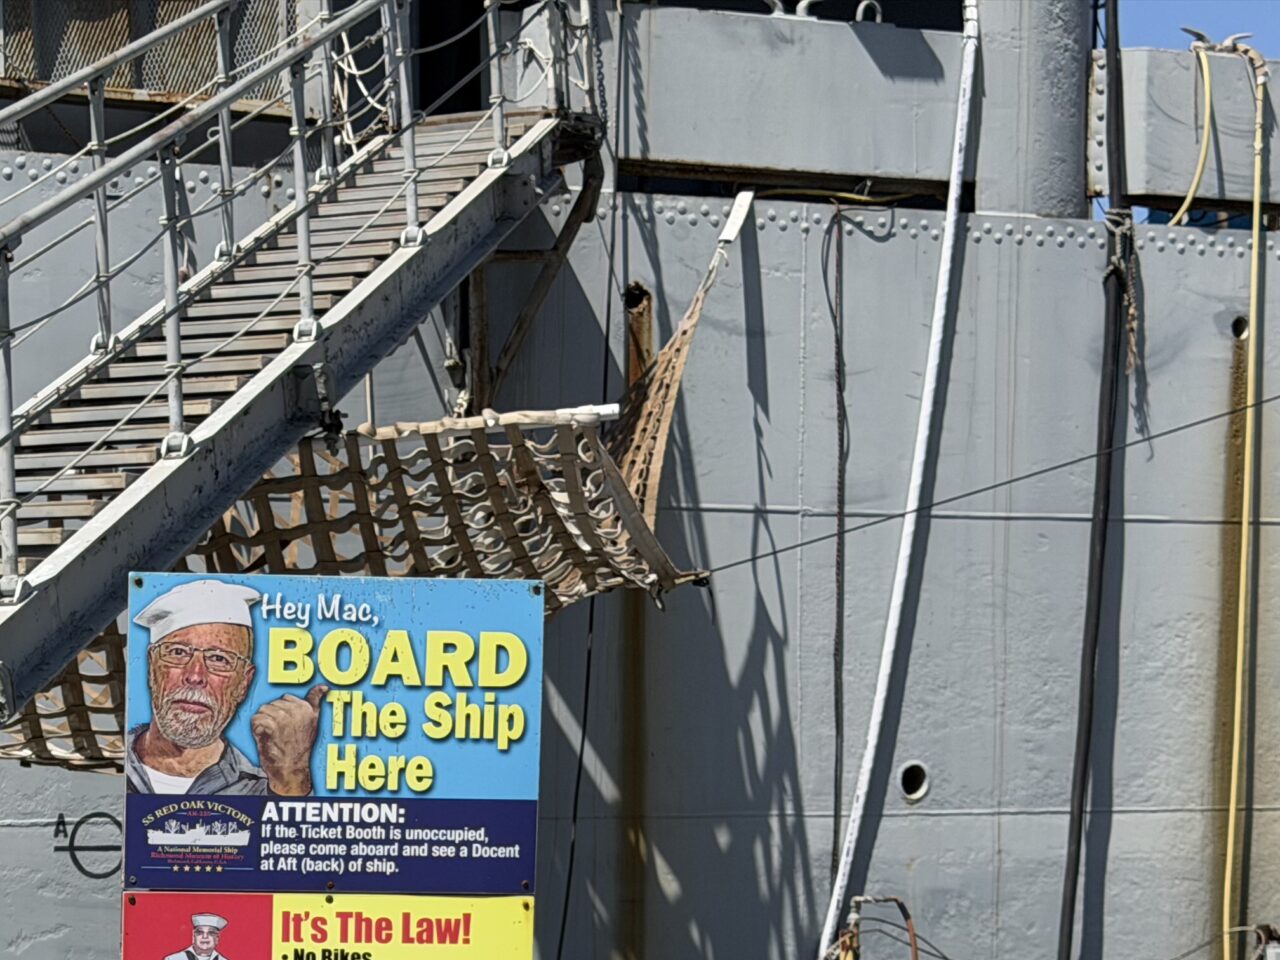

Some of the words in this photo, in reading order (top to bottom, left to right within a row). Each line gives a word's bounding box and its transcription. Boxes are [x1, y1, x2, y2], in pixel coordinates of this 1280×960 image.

[261, 593, 311, 628] Hey
[317, 593, 379, 627] Mac,
[267, 626, 528, 687] BOARD
[325, 690, 407, 738] The
[421, 690, 525, 750] Ship
[325, 743, 433, 792] Here
[53, 813, 69, 838] A
[142, 814, 155, 826] SS
[154, 803, 179, 818] RED
[180, 800, 205, 810] OAK
[207, 800, 255, 827] VICTORY
[261, 801, 405, 823] ATTENTION:
[261, 824, 272, 838] If
[275, 824, 297, 838] the
[300, 824, 342, 839] Ticket
[346, 825, 386, 840] Booth
[389, 825, 402, 840] is
[405, 827, 489, 844] unoccupied,
[260, 840, 306, 857] please
[309, 844, 347, 856] come
[350, 842, 399, 856] aboard
[402, 843, 428, 857] and
[431, 846, 456, 857] see
[459, 846, 468, 857] a
[472, 844, 520, 858] Docent
[260, 857, 274, 871] at
[276, 857, 298, 871] Aft
[301, 858, 345, 875] (back)
[348, 858, 363, 872] of
[366, 858, 399, 876] ship.
[281, 911, 328, 943] It's
[336, 912, 394, 944] The
[401, 912, 472, 944] Law!
